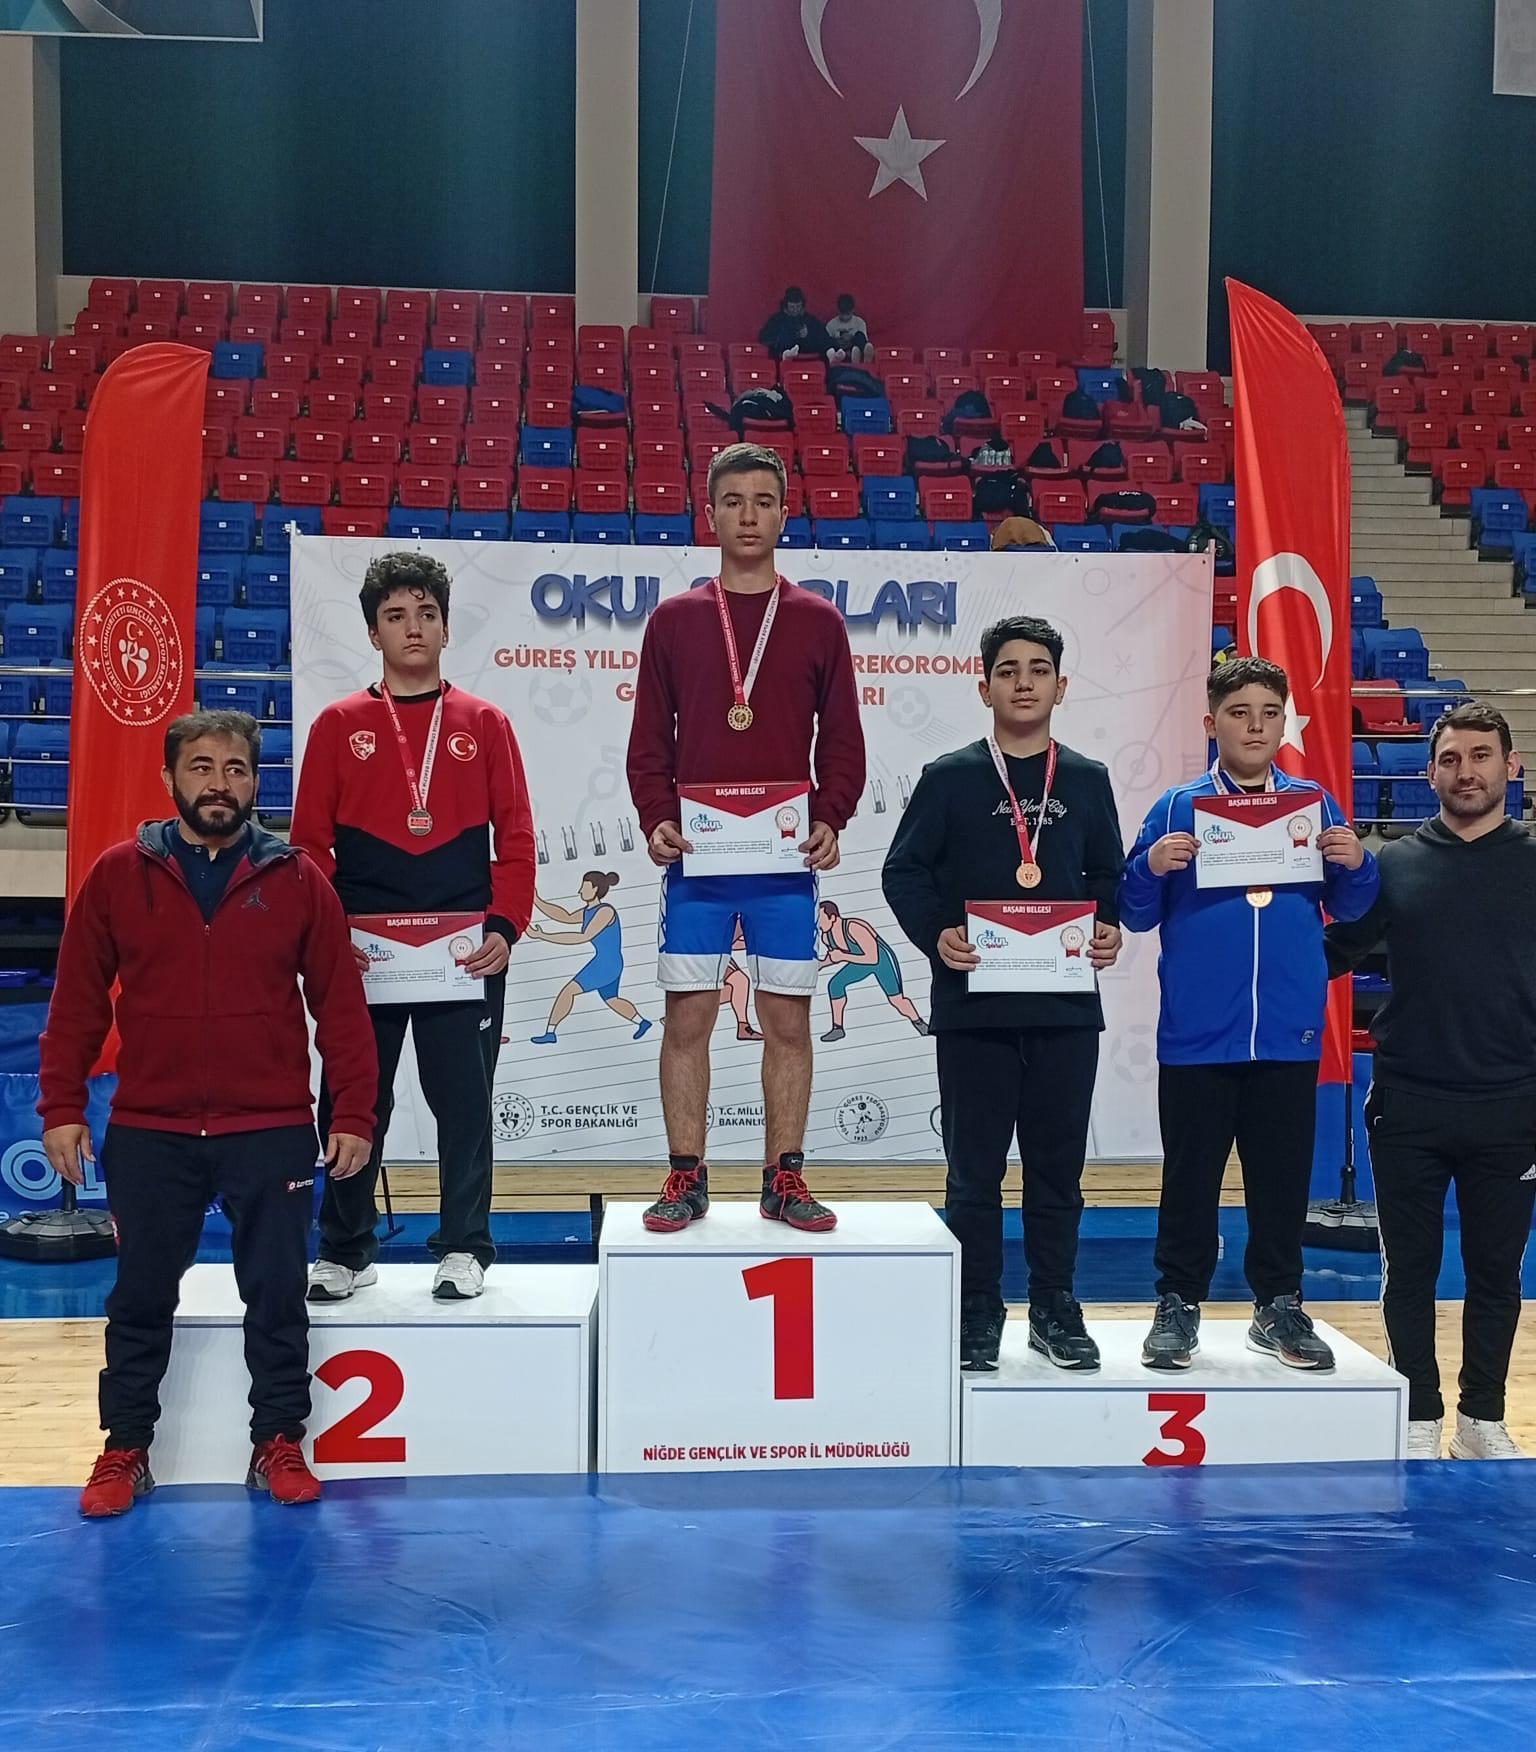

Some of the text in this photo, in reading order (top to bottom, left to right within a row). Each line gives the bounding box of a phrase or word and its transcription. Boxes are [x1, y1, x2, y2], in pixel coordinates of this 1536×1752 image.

[494, 643, 984, 675] GÜREŞ YILD REKOROME
[715, 786, 766, 797] BAŞARI BELGESİ
[1047, 798, 1068, 818] City
[1228, 796, 1278, 807] BAŞARI BELGESİ
[1002, 905, 1052, 914] BAŞARI BELGESİ
[387, 917, 439, 927] BAŞARI BELGESİ
[541, 1103, 638, 1117] T.C. GENÇLİK VE
[719, 1105, 763, 1116] T.C. MİLLİ
[541, 1116, 638, 1128] SPOR BAKANLIĞI
[741, 1257, 814, 1400] 1
[313, 1349, 406, 1464] 2
[1141, 1393, 1206, 1467] 3
[643, 1441, 910, 1462] NİĞDE GENÇLİK VE SPOR İL MÜDÜRLÜĞÜ
